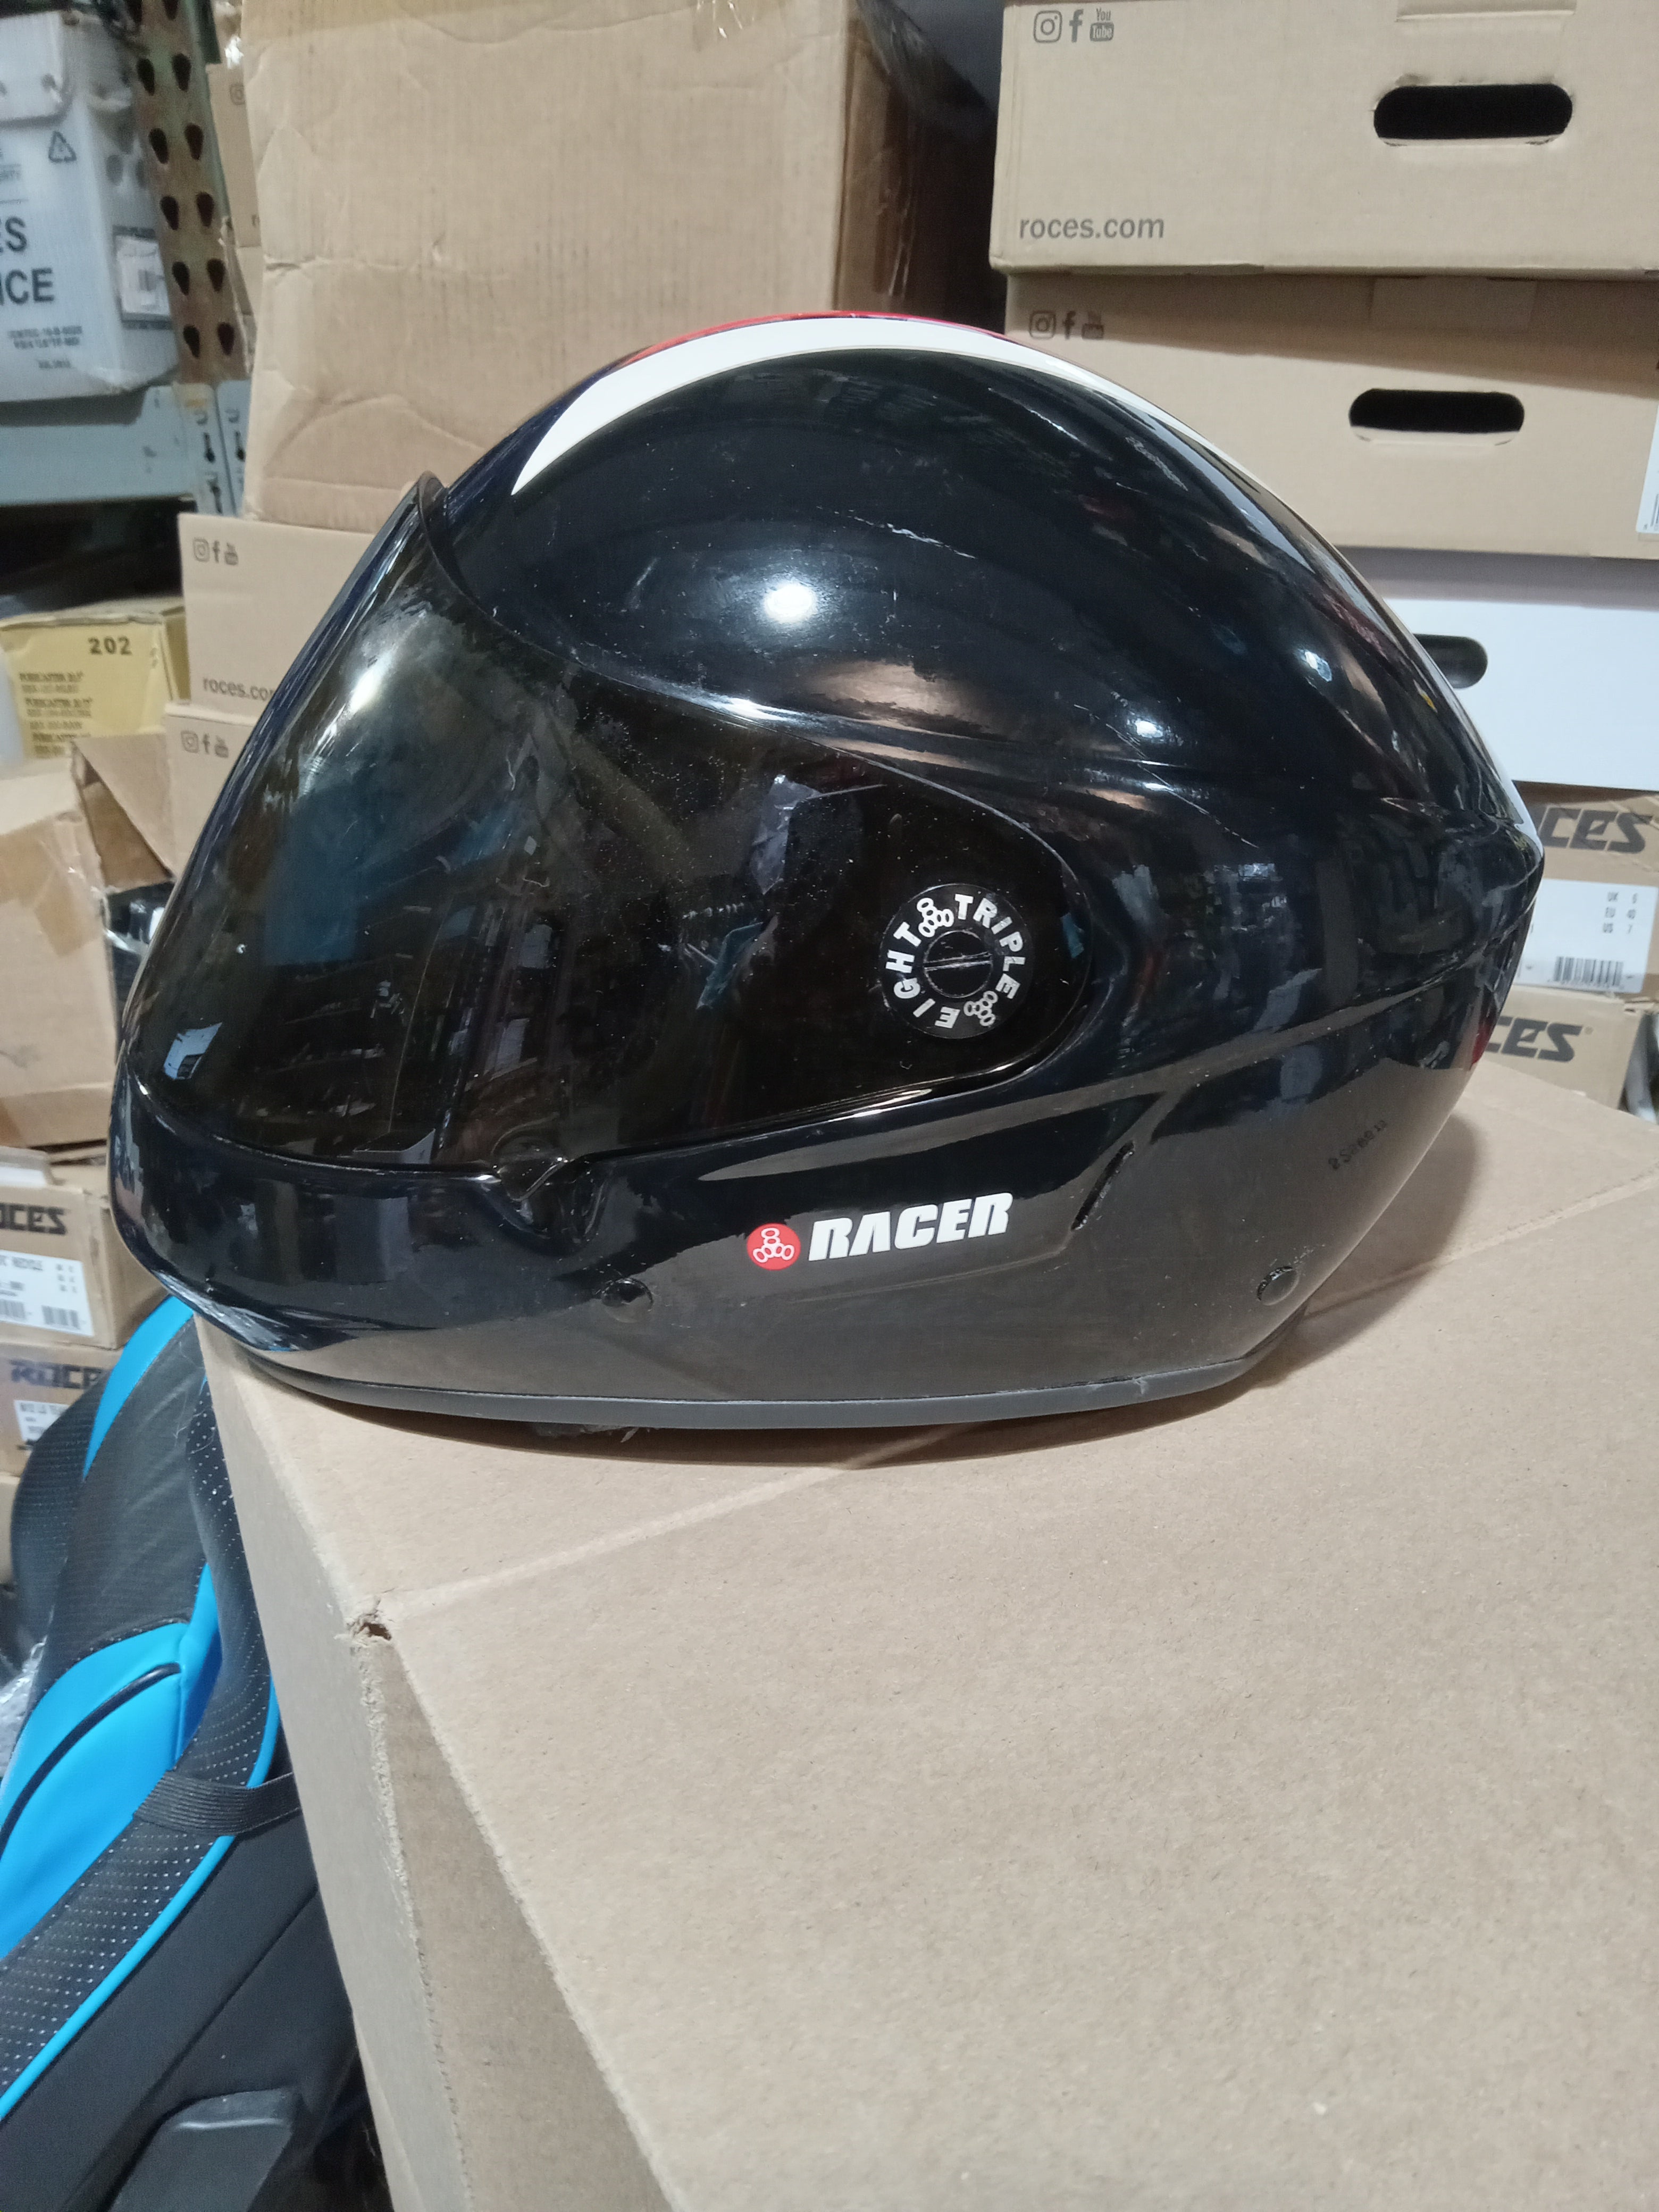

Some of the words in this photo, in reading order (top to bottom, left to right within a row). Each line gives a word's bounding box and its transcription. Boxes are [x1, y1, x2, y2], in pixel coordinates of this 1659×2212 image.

[0, 216, 28, 253] S
[1019, 218, 1164, 239] roces.com
[0, 267, 54, 306] CE
[88, 635, 132, 656] 202
[955, 893, 1026, 999] TRIPLE
[885, 921, 961, 1028] EIGHT
[808, 1192, 1013, 1261] RACER
[10, 1359, 103, 1389] ROCE
